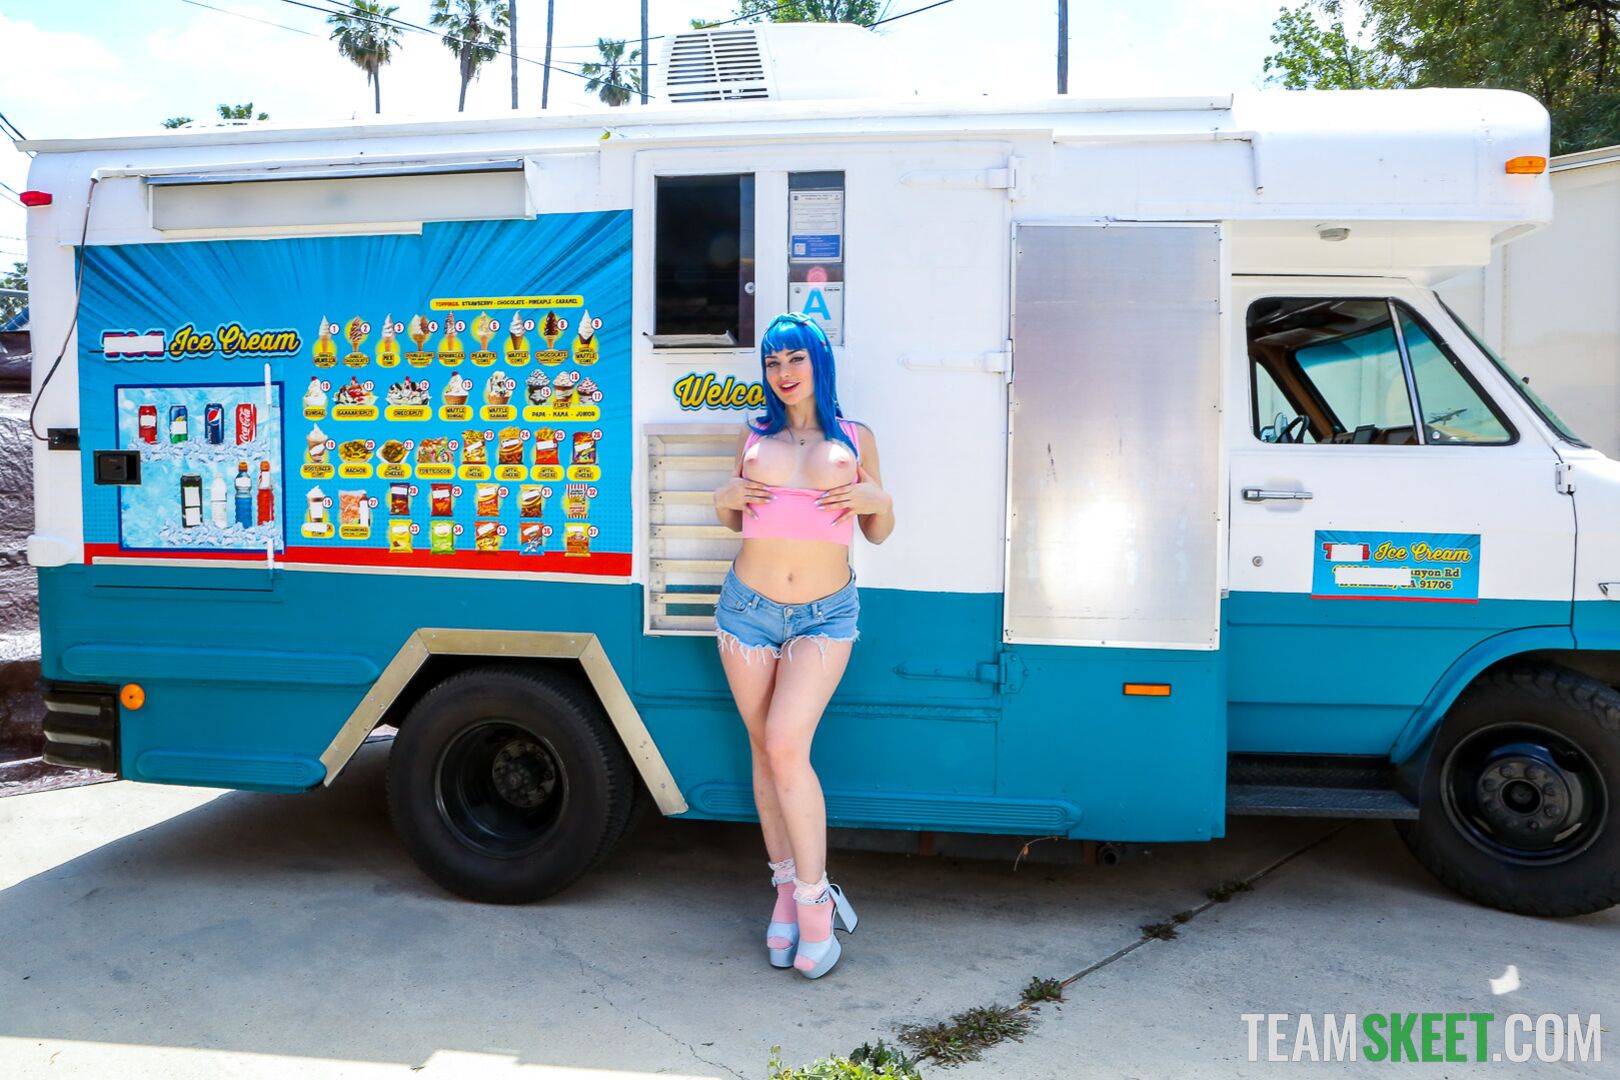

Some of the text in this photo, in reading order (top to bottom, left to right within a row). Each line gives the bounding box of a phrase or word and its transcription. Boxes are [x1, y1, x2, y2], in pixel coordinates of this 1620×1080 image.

[802, 288, 831, 320] A
[170, 326, 214, 354] Ice
[218, 326, 299, 352] Cream
[674, 374, 766, 406] Welco
[1374, 542, 1408, 560] Ice
[1412, 542, 1470, 561] Cream
[1420, 580, 1452, 589] 91706
